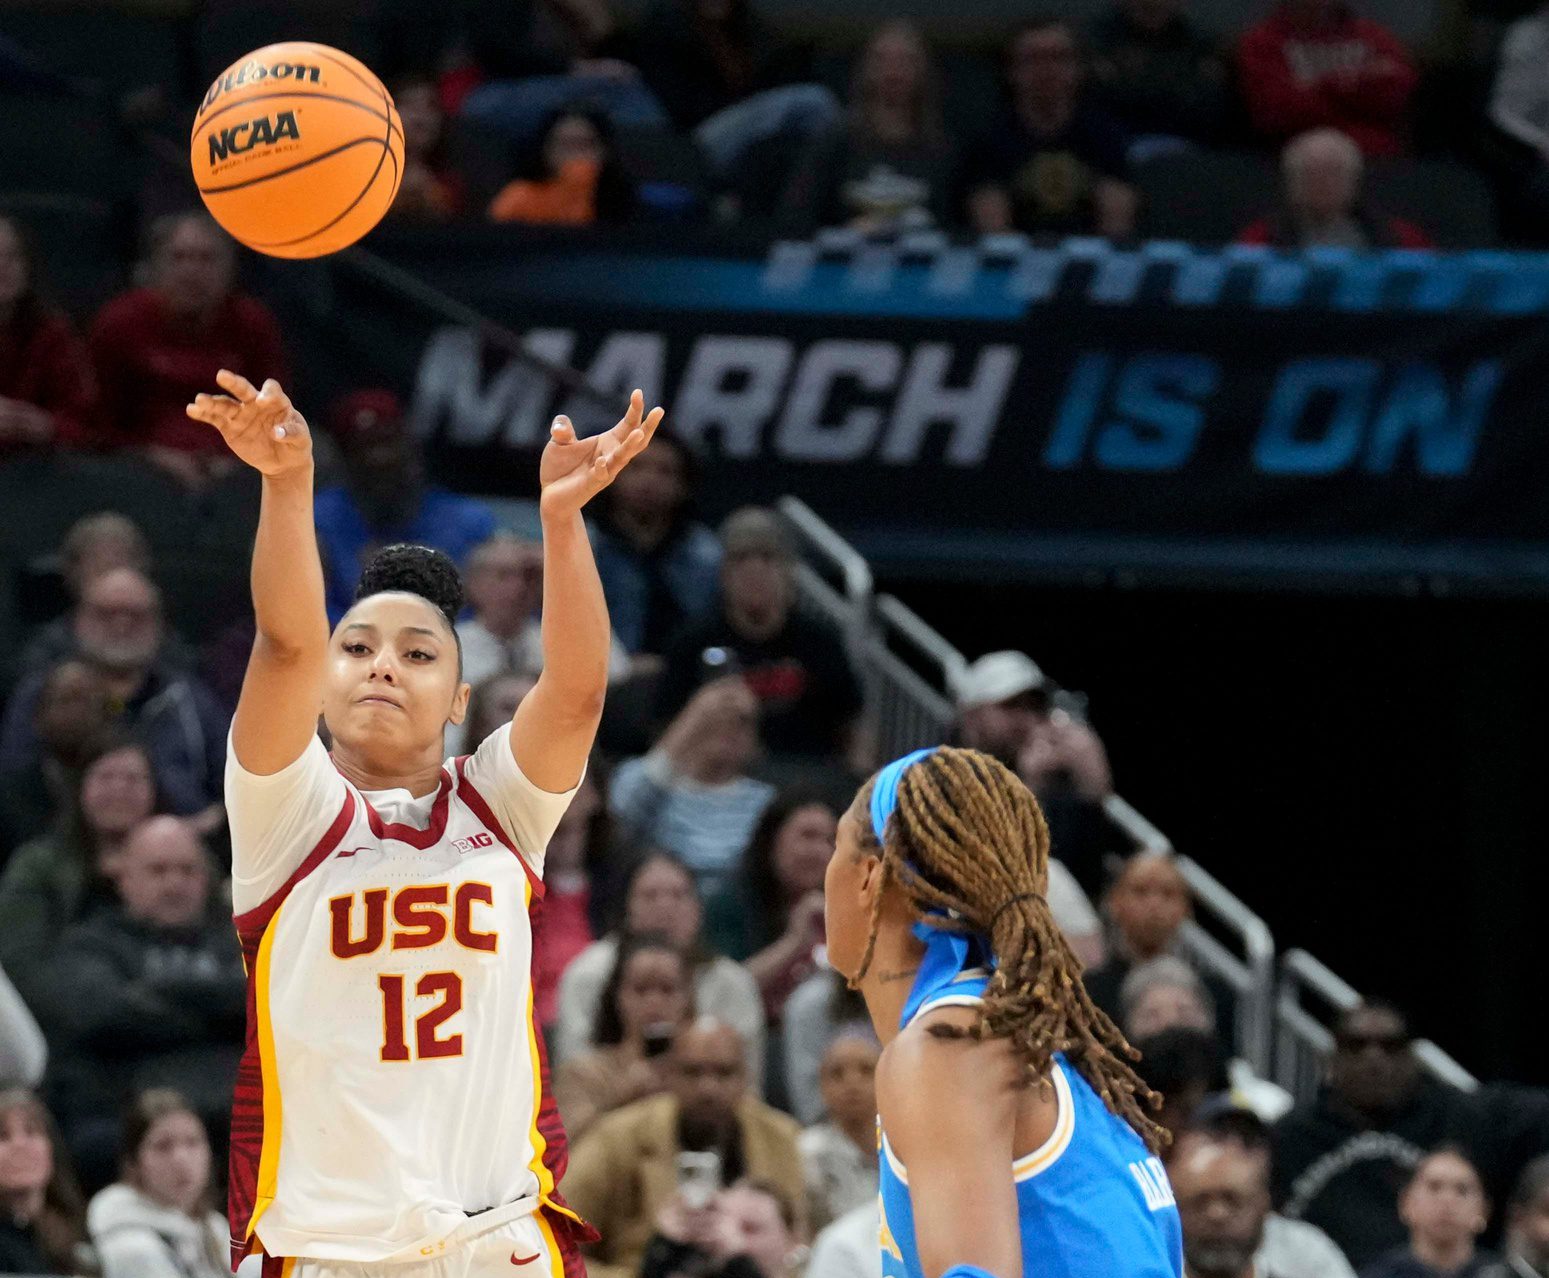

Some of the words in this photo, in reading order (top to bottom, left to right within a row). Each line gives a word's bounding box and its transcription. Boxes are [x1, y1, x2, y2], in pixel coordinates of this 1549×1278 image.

[208, 111, 300, 167] NCAA
[417, 325, 1020, 465] MARCH
[1042, 352, 1222, 471] IS
[1253, 357, 1503, 476] ON
[329, 880, 498, 960] USC
[377, 971, 464, 1062] 12
